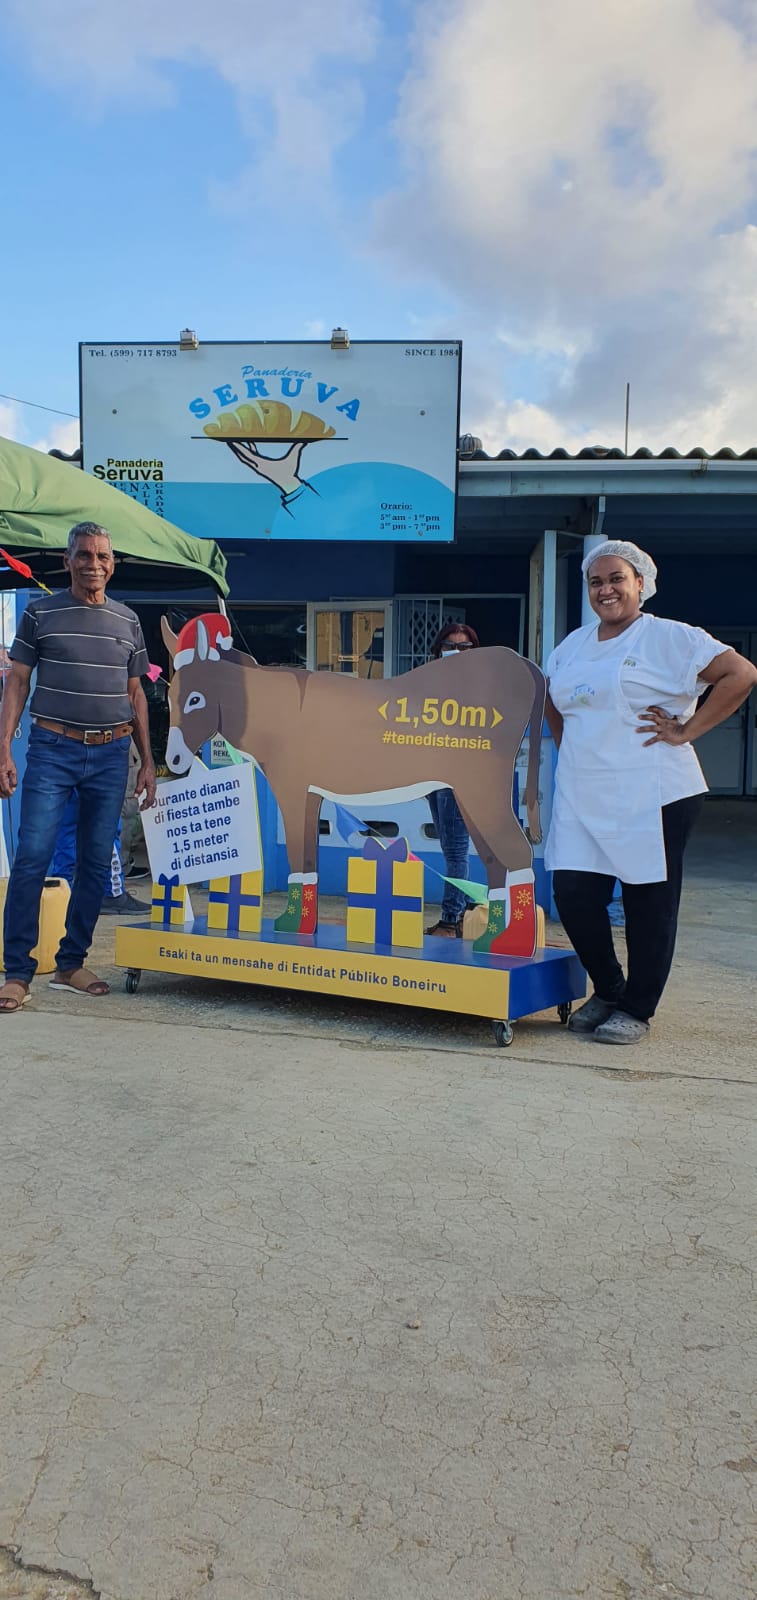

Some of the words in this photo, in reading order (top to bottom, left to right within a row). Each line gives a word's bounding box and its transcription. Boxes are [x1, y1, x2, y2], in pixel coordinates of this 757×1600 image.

[89, 349, 107, 357] Tel.
[110, 349, 134, 358] (599)
[155, 349, 177, 357] 8793
[188, 377, 361, 421] SERUVA
[93, 464, 164, 481] Seruva
[107, 458, 164, 468] Panaderia
[380, 502, 413, 510] Orario:
[382, 730, 491, 750] #tenedistansia
[199, 779, 240, 797] dianan
[154, 811, 165, 825] di
[166, 804, 201, 822] fiesta
[202, 795, 240, 813] tambe
[166, 825, 188, 838] nos
[190, 822, 203, 833] ta
[204, 815, 231, 830] tene
[173, 840, 191, 854] 1,5
[193, 833, 230, 849] meter
[170, 857, 182, 871] di
[183, 847, 239, 868] distansia
[159, 946, 188, 960] Esaki
[191, 951, 202, 962] ta
[205, 955, 219, 964] un
[222, 955, 274, 971] mensahe
[277, 960, 288, 972] di
[292, 962, 336, 979] Entidat
[340, 968, 388, 985] Públiko
[392, 975, 447, 994] Boneiru
